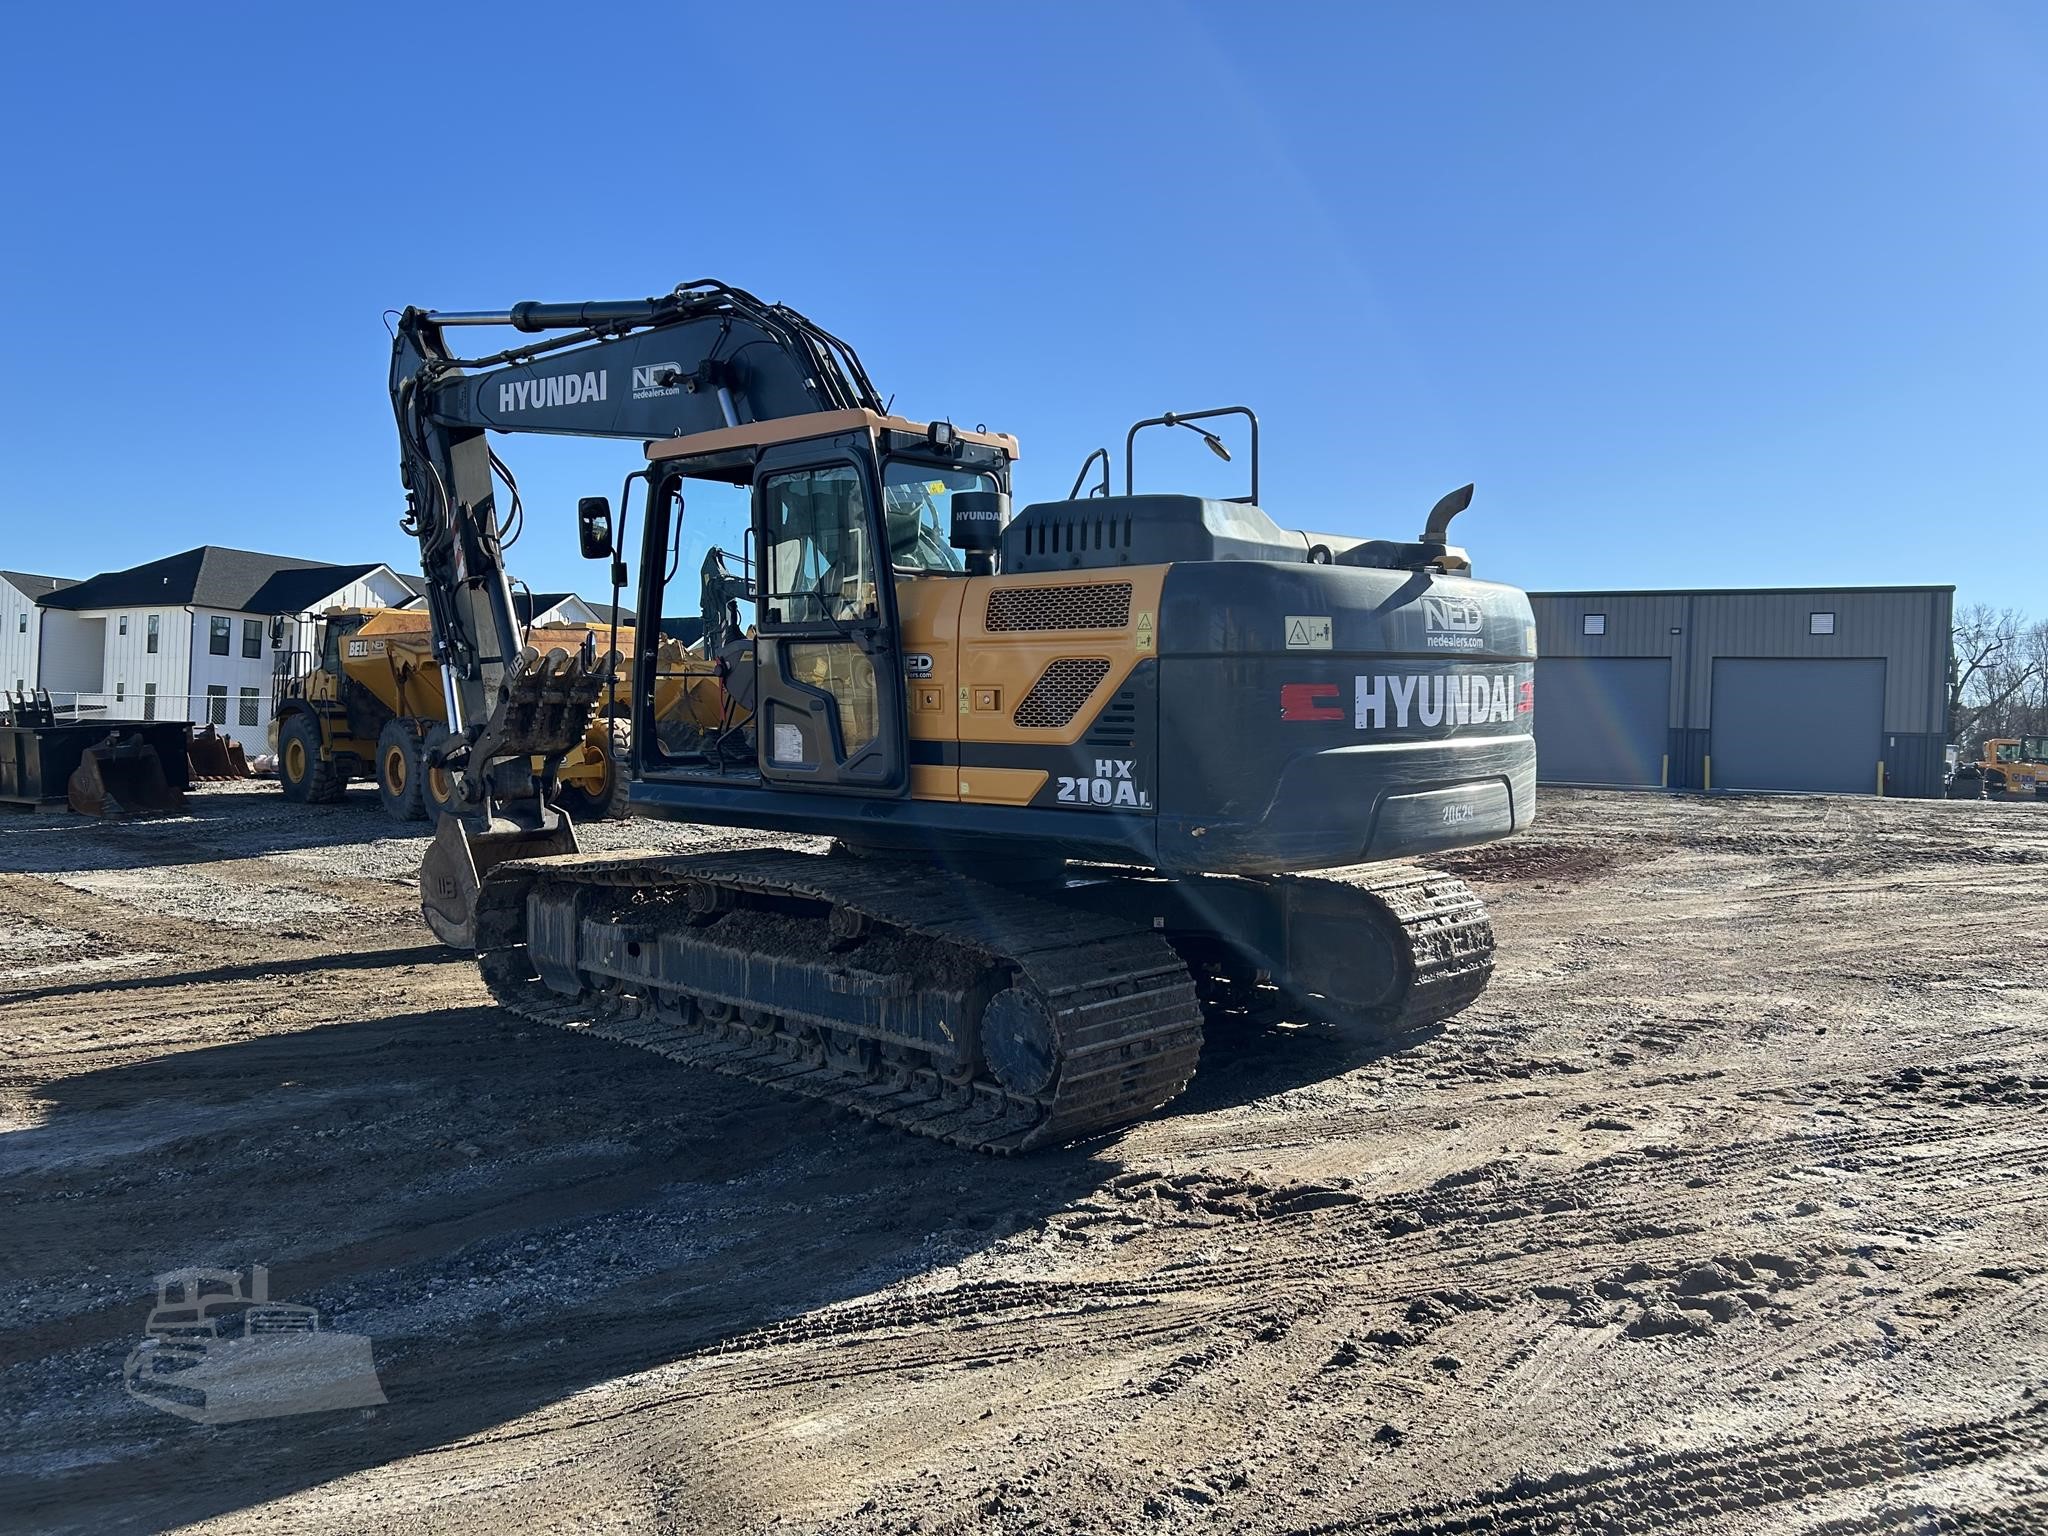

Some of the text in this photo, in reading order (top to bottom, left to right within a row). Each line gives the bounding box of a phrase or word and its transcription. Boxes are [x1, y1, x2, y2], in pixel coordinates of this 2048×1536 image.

[500, 370, 607, 413] HYUNDAI
[633, 387, 680, 399] nedealers.com
[956, 511, 1004, 520] HYUNDAI
[1423, 599, 1482, 631] NED
[349, 641, 368, 657] BELL
[1427, 634, 1483, 648] nedealers.com
[904, 655, 933, 670] ED
[1355, 675, 1515, 729] HYUNDAI
[1095, 759, 1133, 778] HX
